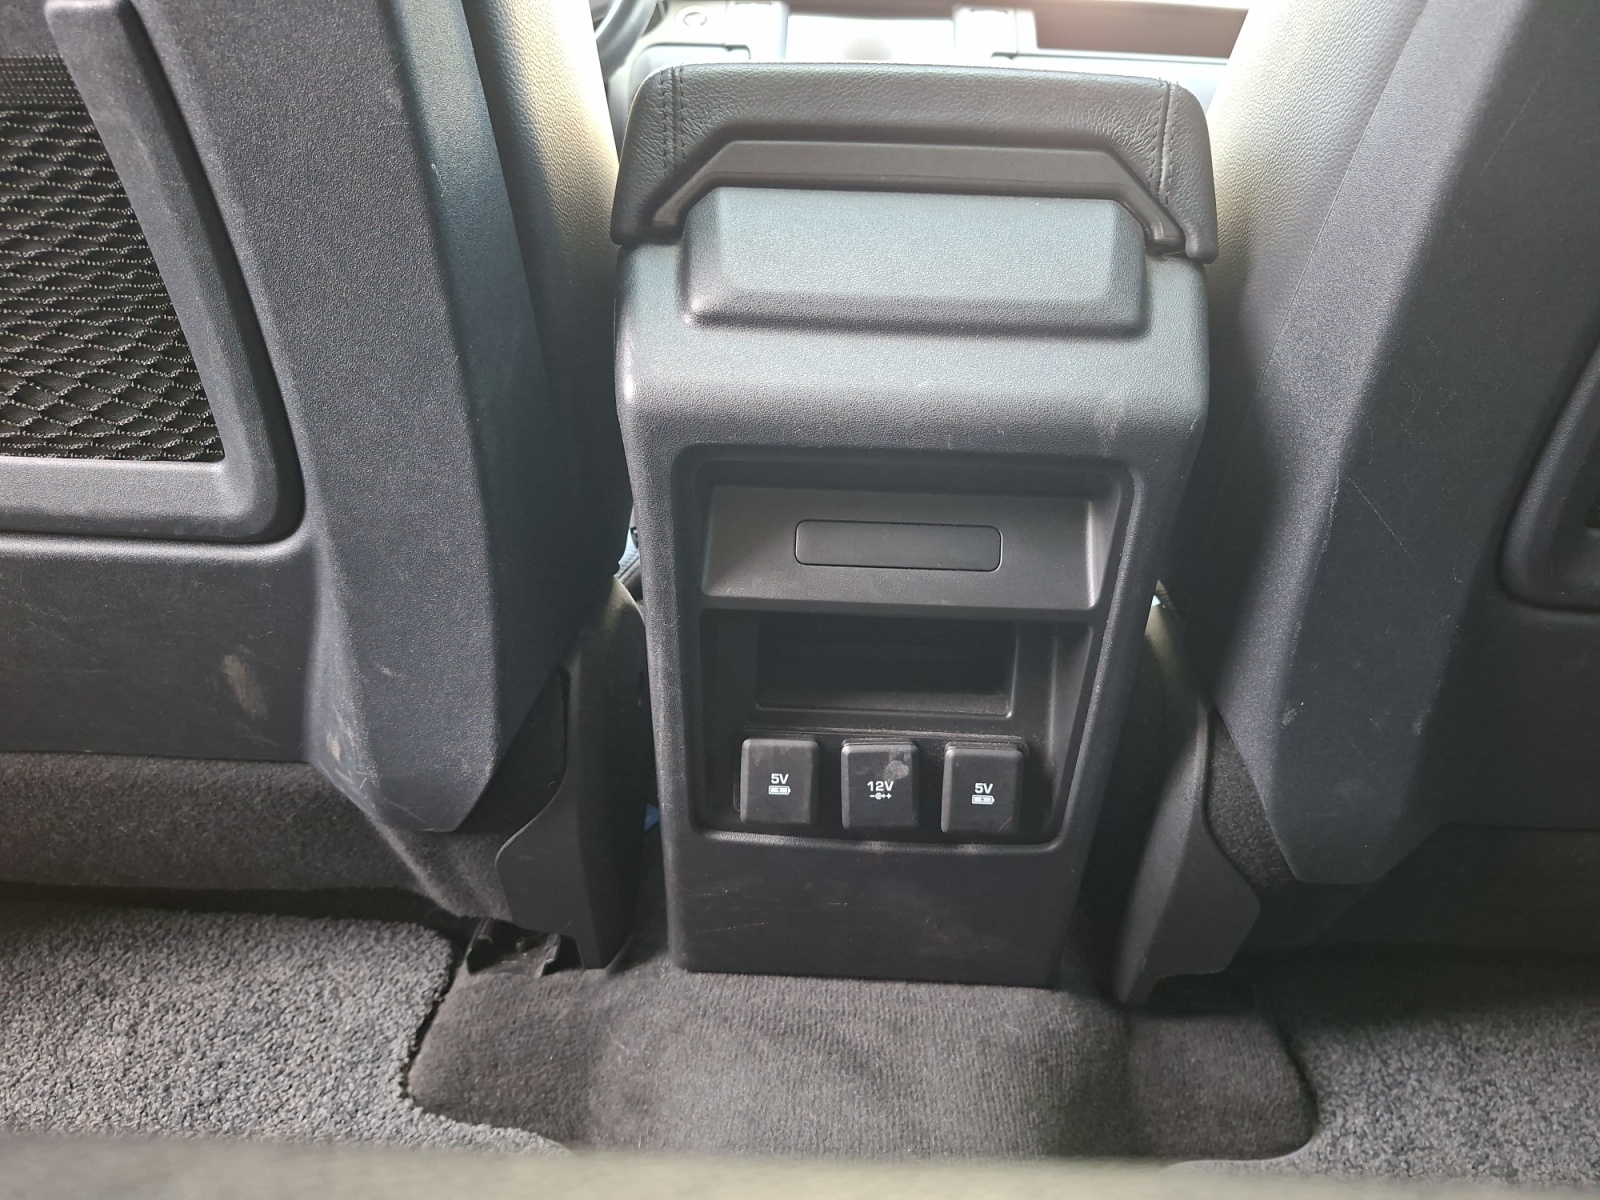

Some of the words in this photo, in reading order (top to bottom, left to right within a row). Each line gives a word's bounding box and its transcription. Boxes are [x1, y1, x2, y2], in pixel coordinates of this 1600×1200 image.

[770, 773, 789, 785] 5V
[866, 780, 894, 792] 12V
[974, 782, 993, 794] 5V
